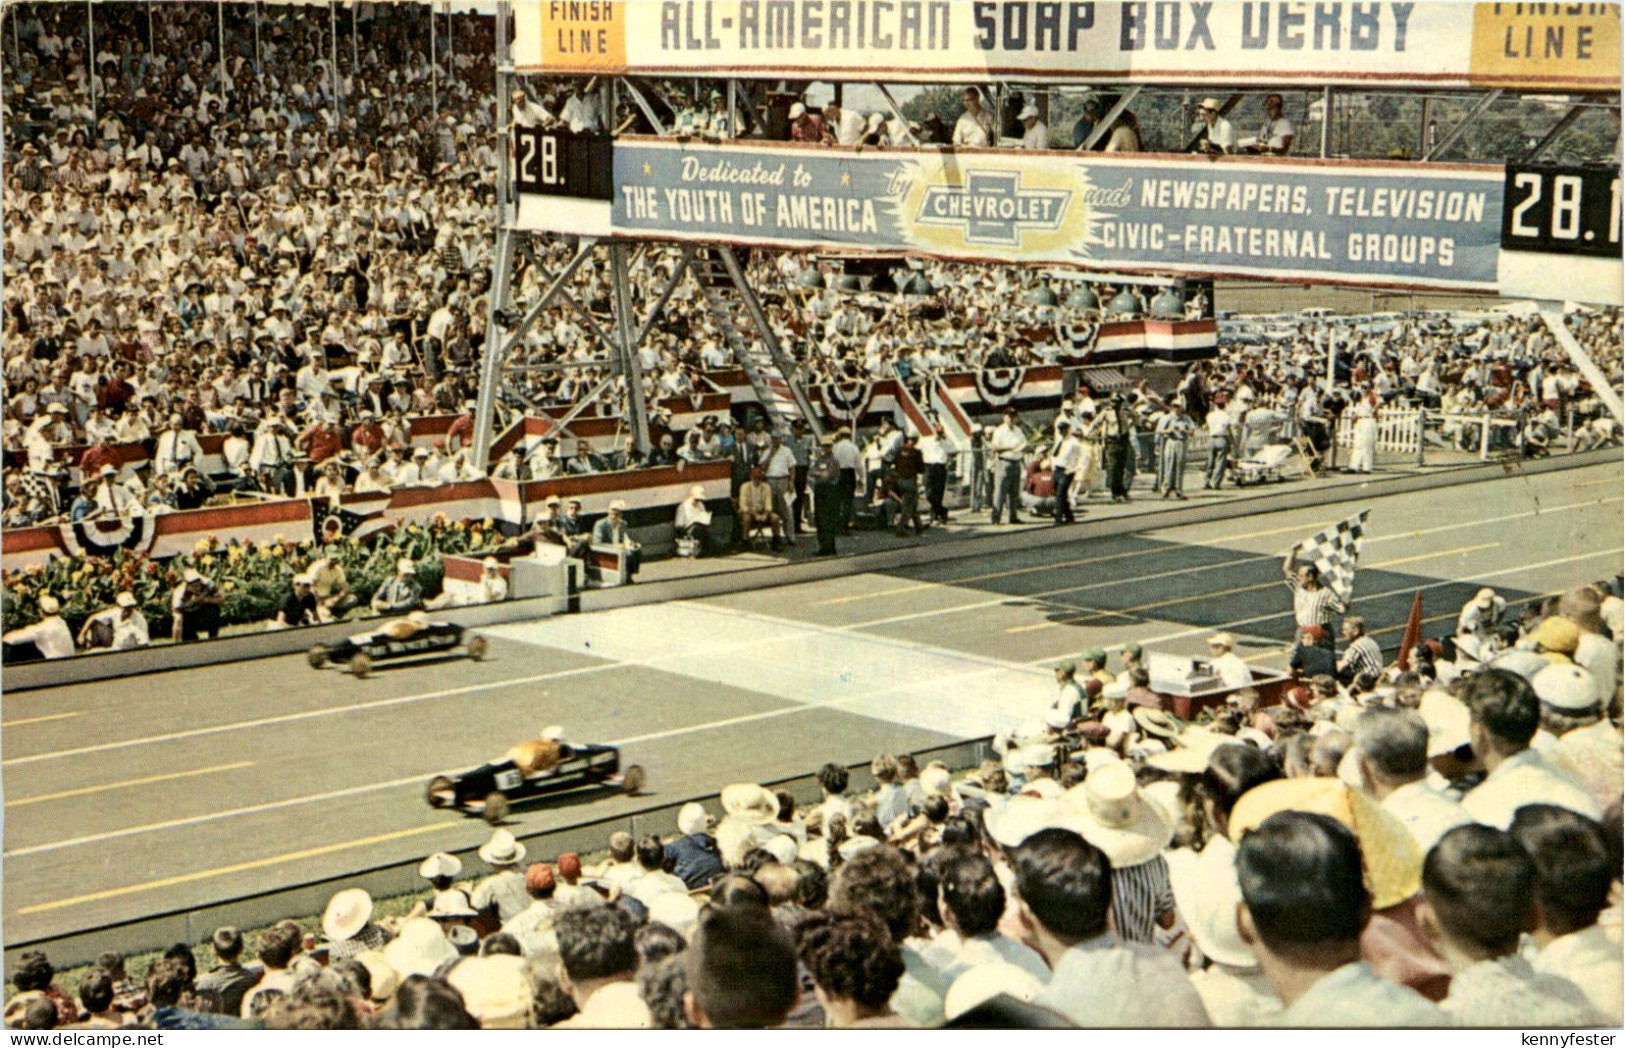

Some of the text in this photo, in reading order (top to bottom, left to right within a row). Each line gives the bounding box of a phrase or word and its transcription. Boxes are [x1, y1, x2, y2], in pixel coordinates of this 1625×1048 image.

[549, 1, 613, 21] FINISH
[660, 1, 1414, 52] ALL-AMERICAN SOAP BOX DERBY
[557, 28, 608, 54] LINE
[1504, 25, 1593, 60] LINE
[519, 134, 566, 185] 28.
[681, 156, 812, 187] Dedicated to
[622, 185, 878, 234] THE YOUTH OF AMERICA
[933, 195, 1053, 220] CHEVROLET
[1084, 177, 1132, 208] and
[1326, 187, 1485, 223] TELEVISION
[1511, 172, 1621, 243] 28.1
[1103, 221, 1455, 267] CIVIC-FRATERNAL GROUPS
